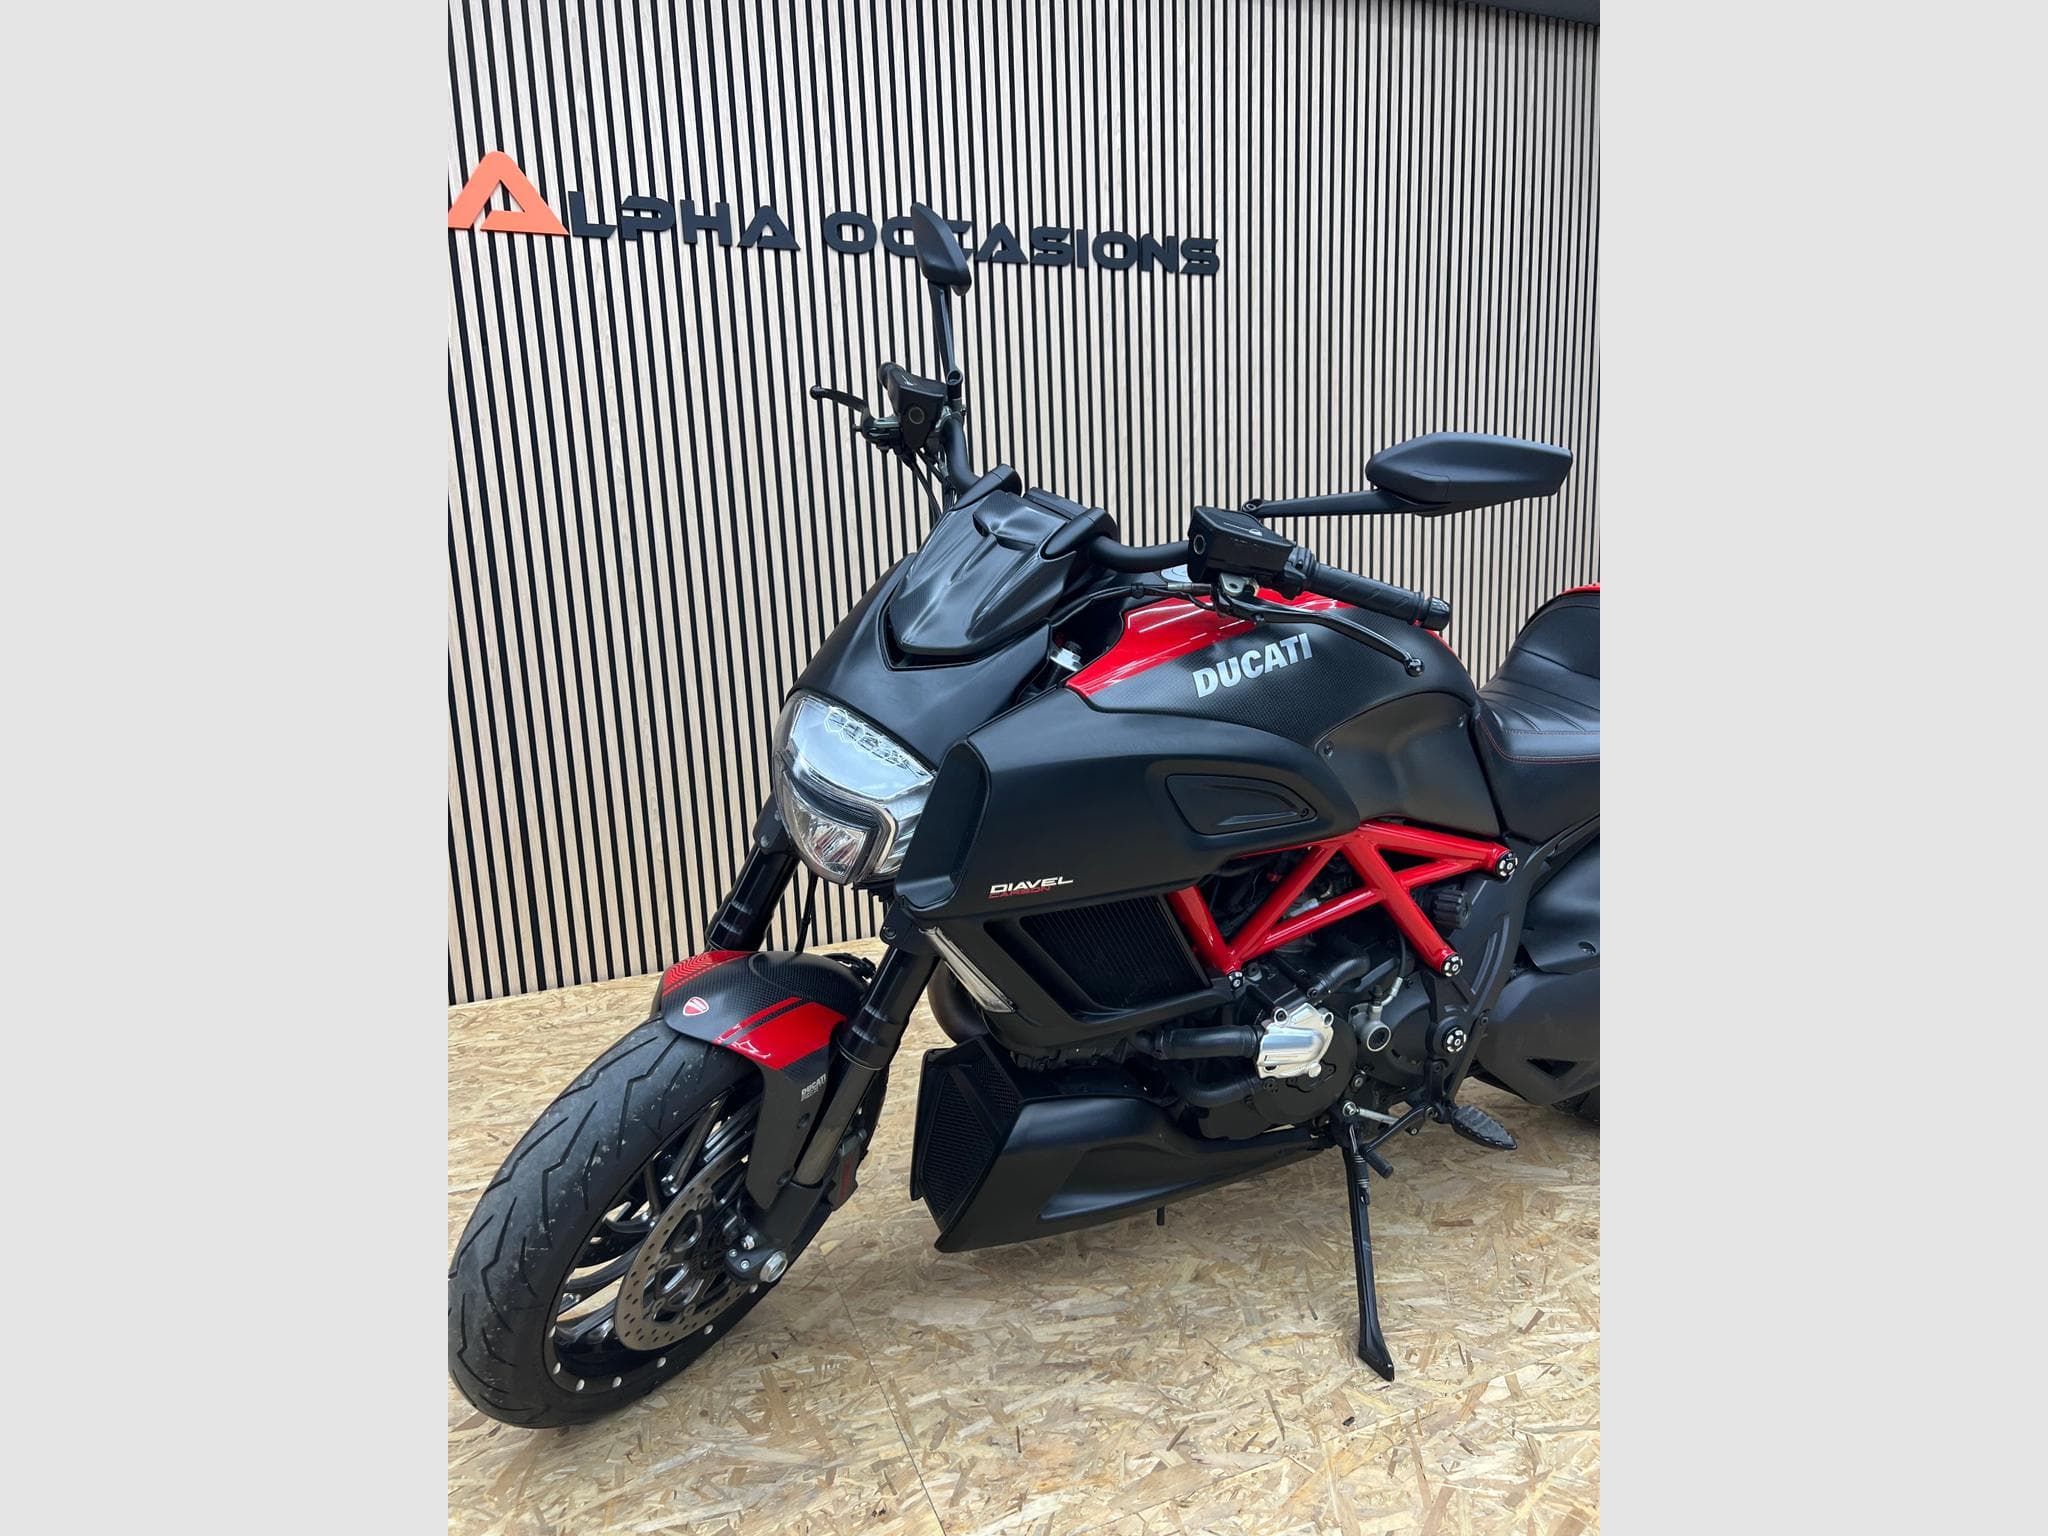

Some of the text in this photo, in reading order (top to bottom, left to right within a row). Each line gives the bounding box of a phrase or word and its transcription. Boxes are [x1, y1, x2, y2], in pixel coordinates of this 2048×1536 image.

[448, 151, 801, 251] ALPHA
[1193, 633, 1312, 698] DUCATI
[990, 877, 1073, 893] DIAVEL
[802, 1073, 827, 1095] DUCATI
